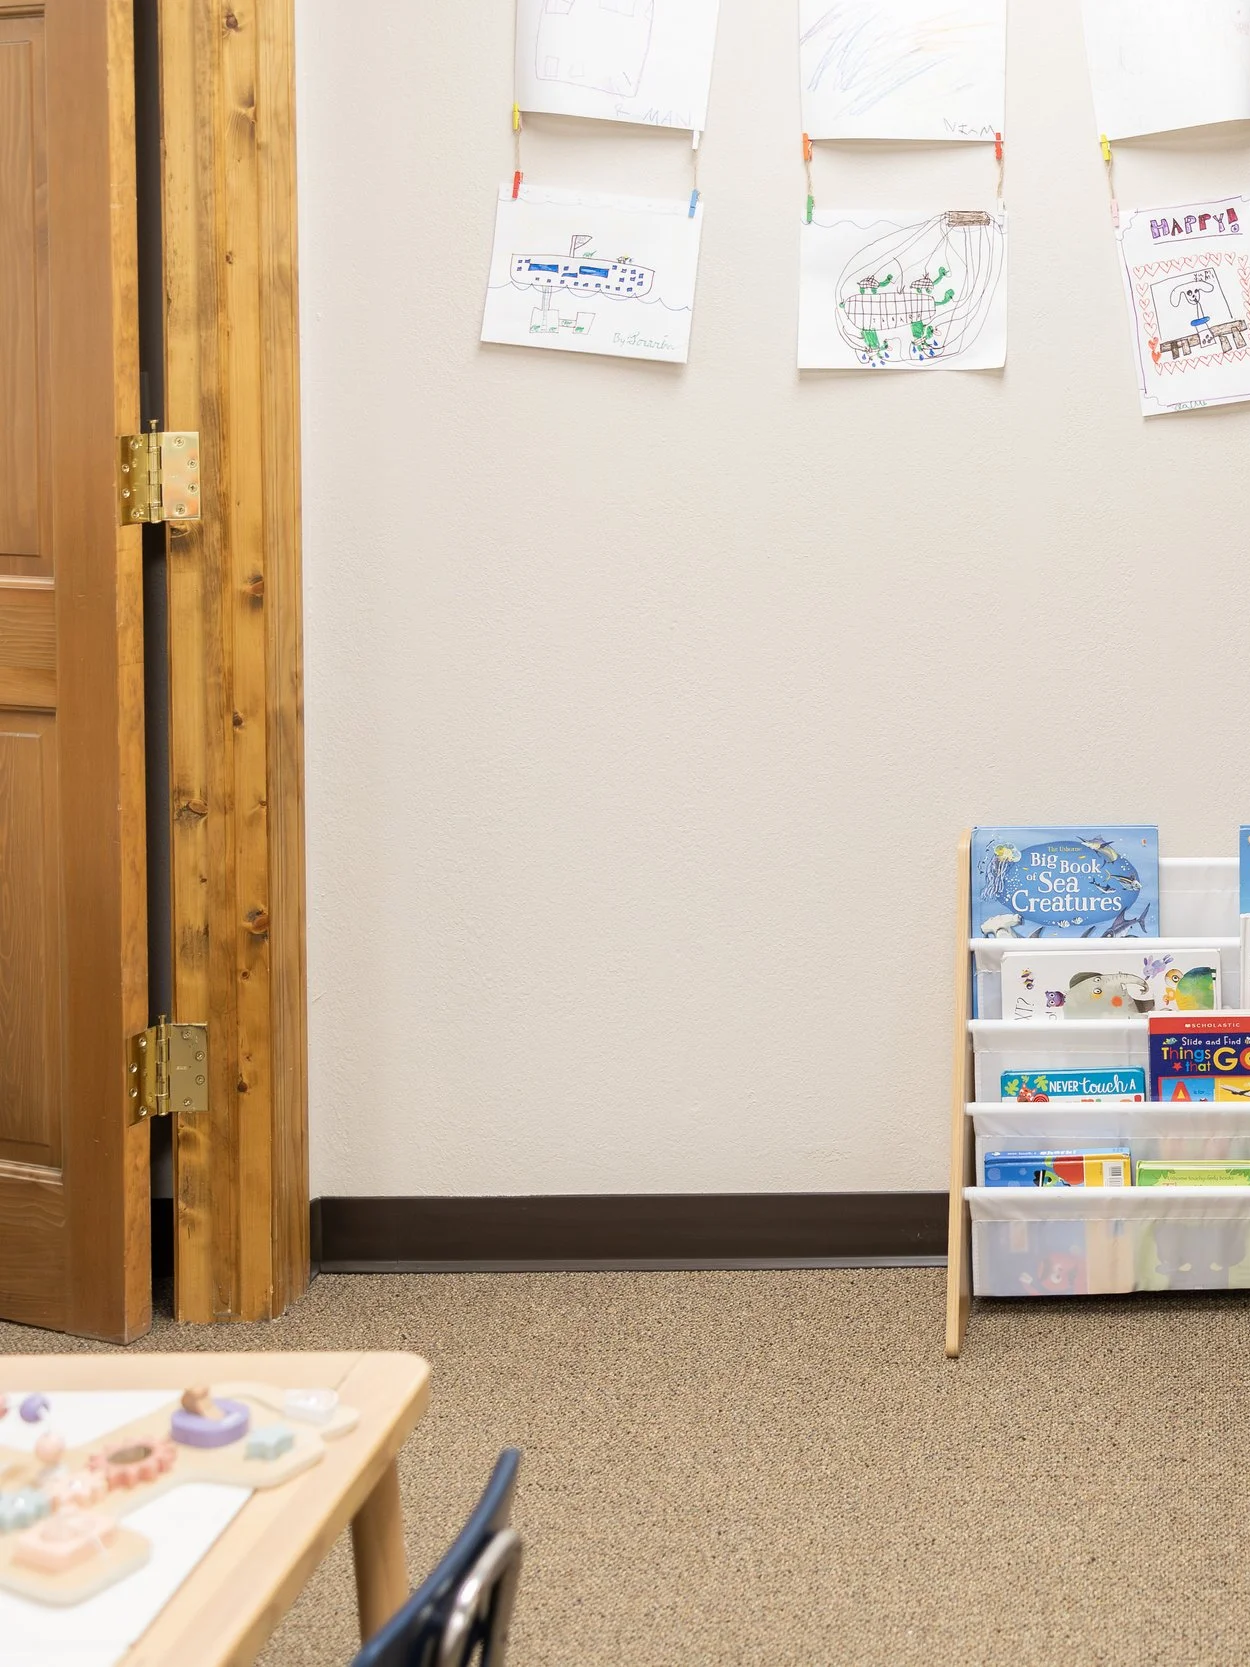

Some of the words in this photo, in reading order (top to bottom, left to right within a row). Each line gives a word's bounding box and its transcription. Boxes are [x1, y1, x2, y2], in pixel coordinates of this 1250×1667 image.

[1149, 207, 1240, 239] HAPPY!
[1030, 852, 1058, 869] Big
[1060, 859, 1101, 874] Book
[1026, 872, 1037, 881] of
[1038, 871, 1080, 893] Sea
[1011, 889, 1122, 912] Creatures
[1181, 1036, 1203, 1046] Slide
[1223, 1035, 1242, 1045] Find
[1161, 1046, 1212, 1063] Things
[1185, 1061, 1212, 1072] that
[1049, 1080, 1079, 1093] NEVER
[1079, 1074, 1128, 1094] touch
[1129, 1079, 1137, 1090] A
